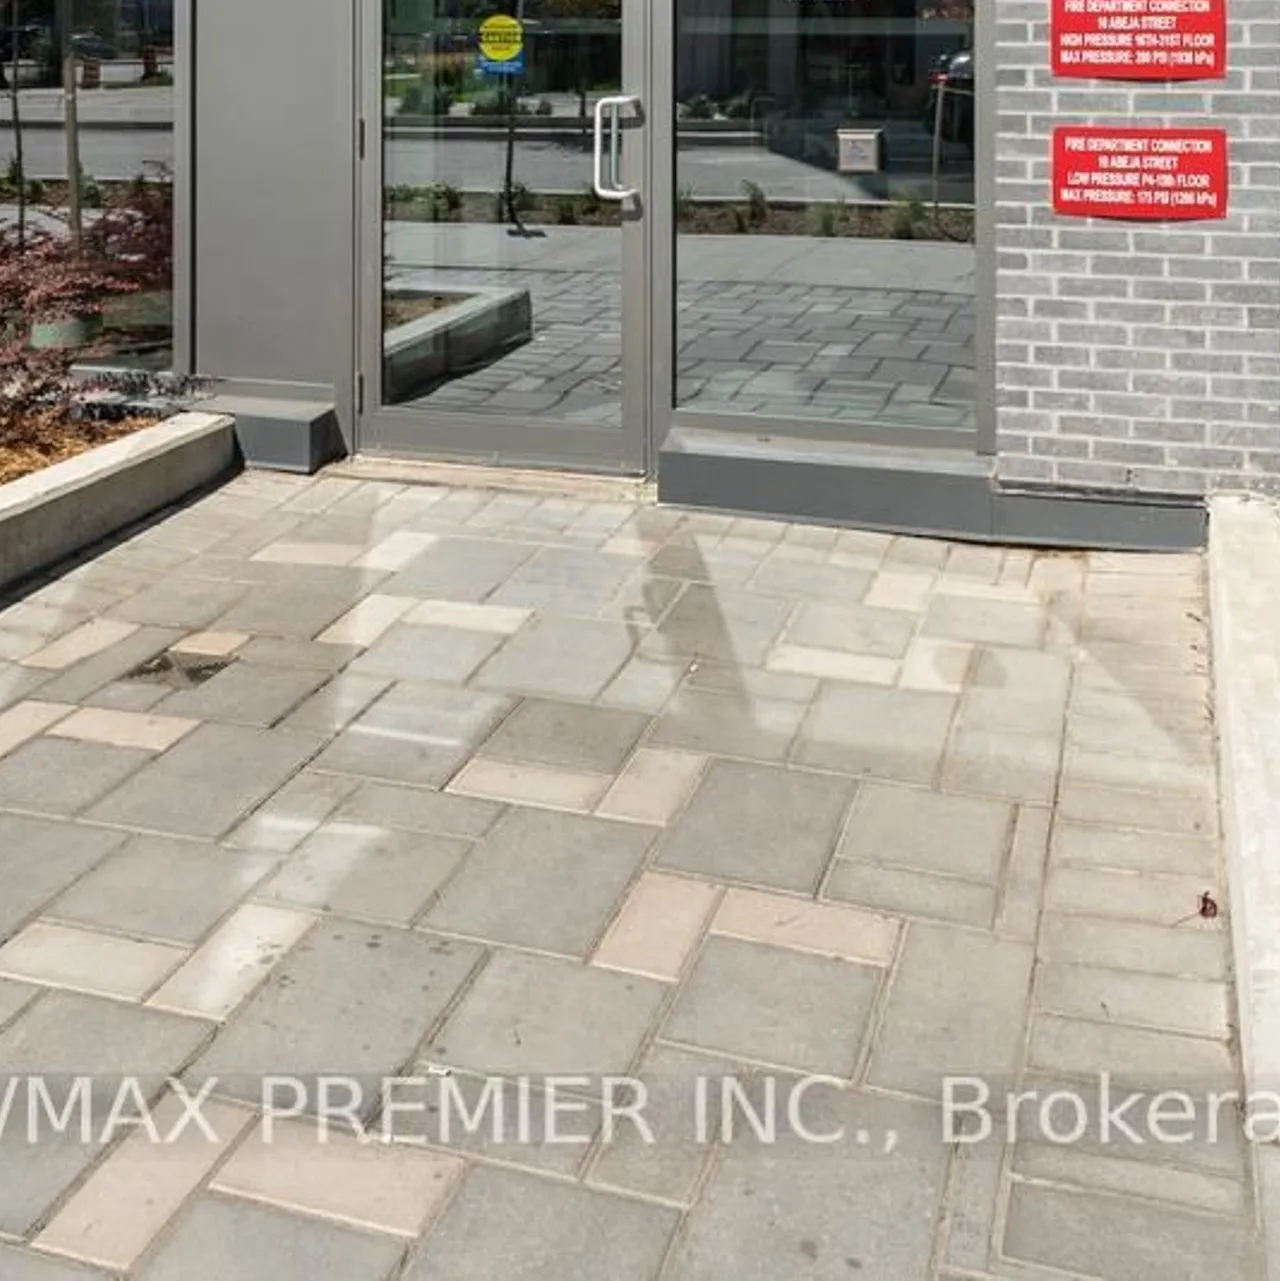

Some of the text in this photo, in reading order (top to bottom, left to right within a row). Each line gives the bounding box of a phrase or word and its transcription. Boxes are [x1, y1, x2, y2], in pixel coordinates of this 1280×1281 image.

[1065, 0, 1210, 12] FIRE DEPARTMENT CONNECTION
[1109, 17, 1140, 29] ABEJA
[1142, 16, 1176, 29] STREET
[1084, 34, 1133, 46] PRESSURE
[1183, 34, 1215, 46] FLOOR
[1061, 50, 1080, 63] MAX
[1065, 137, 1212, 152] FIRE DEPARTMENT CONNECTION
[1111, 156, 1140, 168] ABEJA
[1142, 157, 1178, 169] STREET
[1067, 172, 1089, 185] LOW
[1091, 172, 1140, 186] PRESSURE
[1178, 175, 1210, 187] FLOOR
[1061, 189, 1083, 200] MAX
